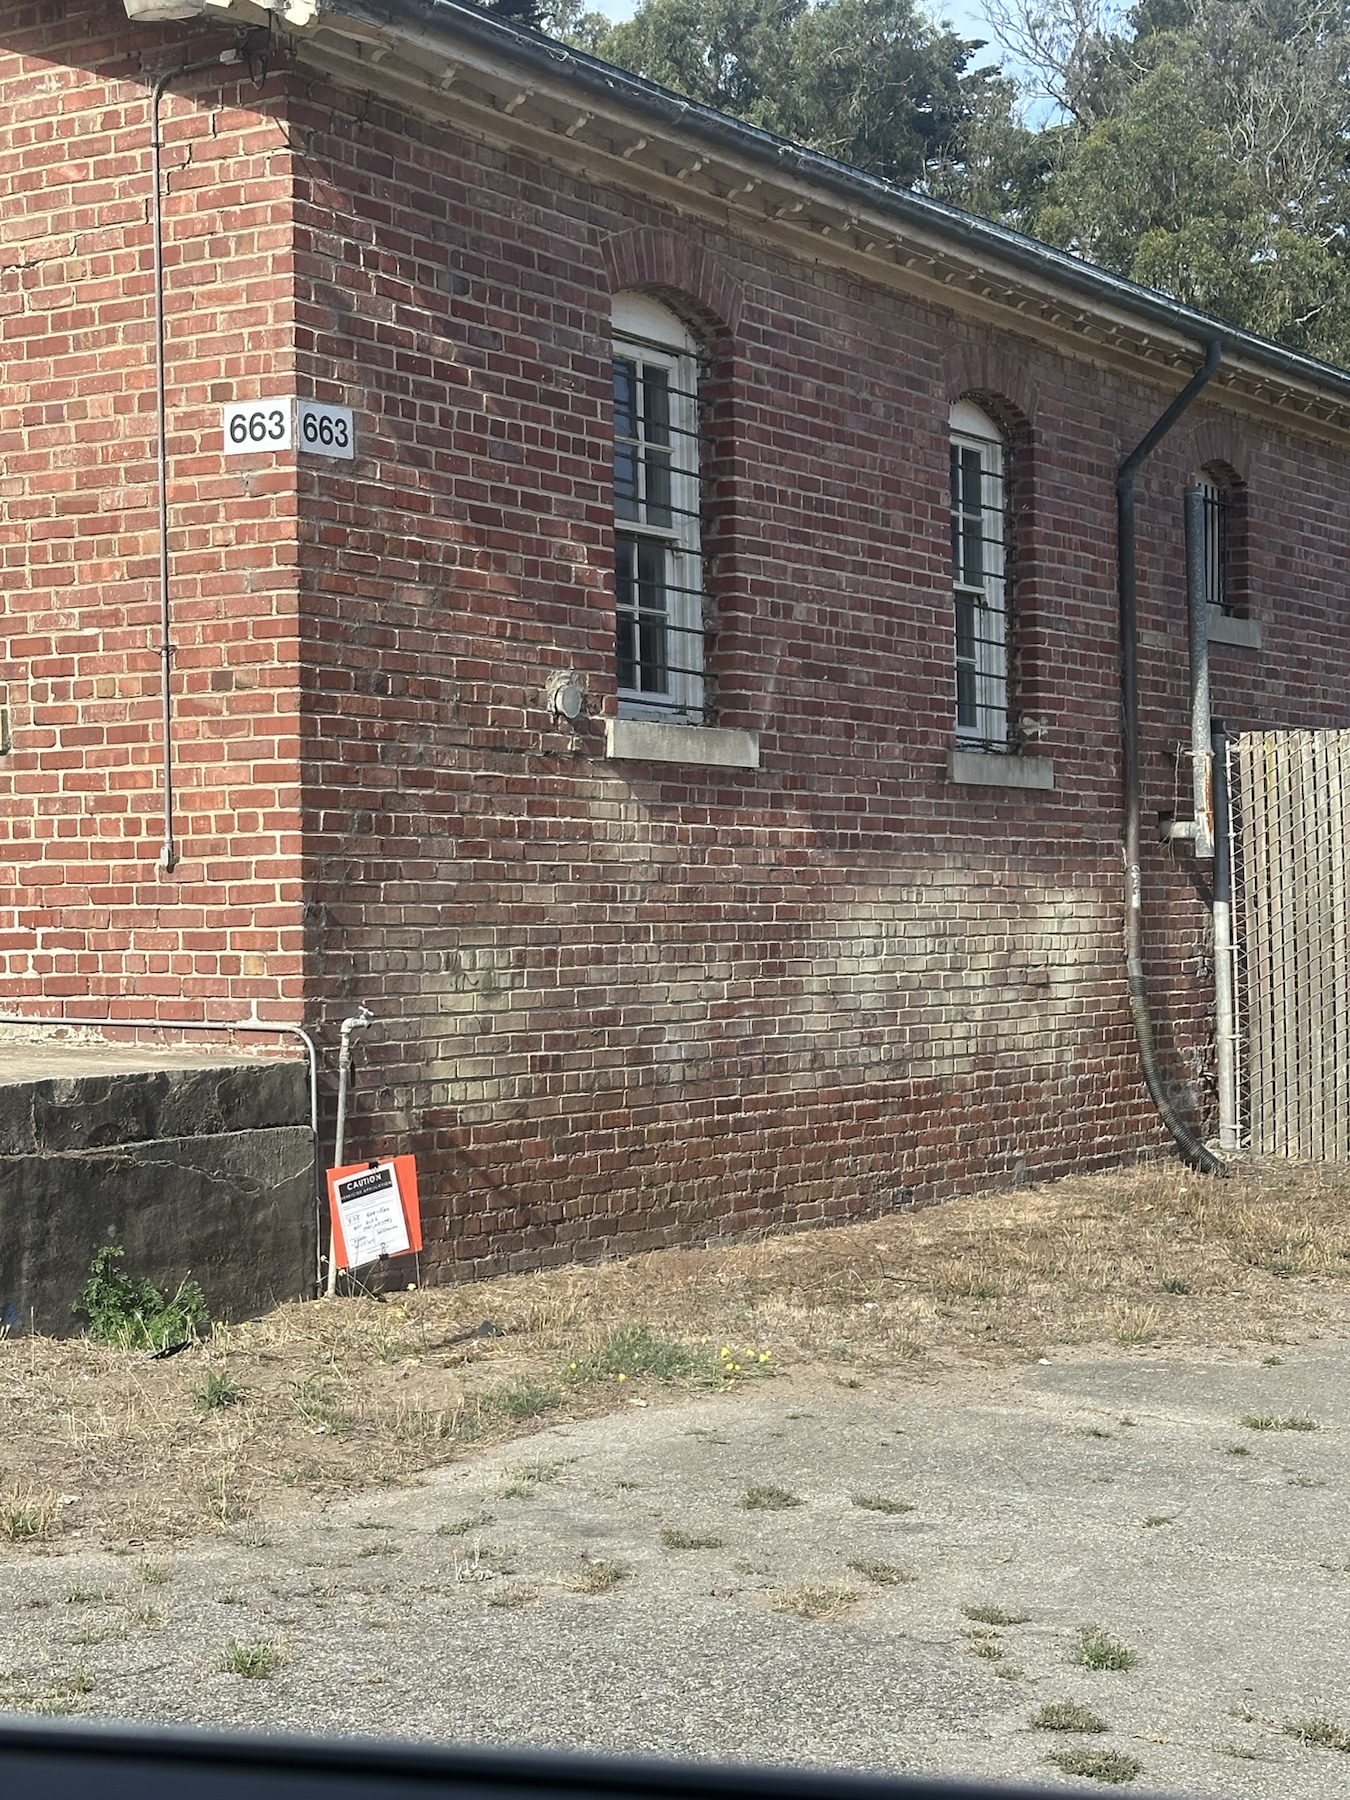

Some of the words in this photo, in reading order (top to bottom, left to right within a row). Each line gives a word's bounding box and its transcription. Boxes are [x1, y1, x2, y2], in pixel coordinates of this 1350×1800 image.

[230, 410, 285, 443] 663
[303, 412, 349, 448] 663
[346, 1173, 382, 1190] CAUTION
[363, 1181, 392, 1193] APPLICATION
